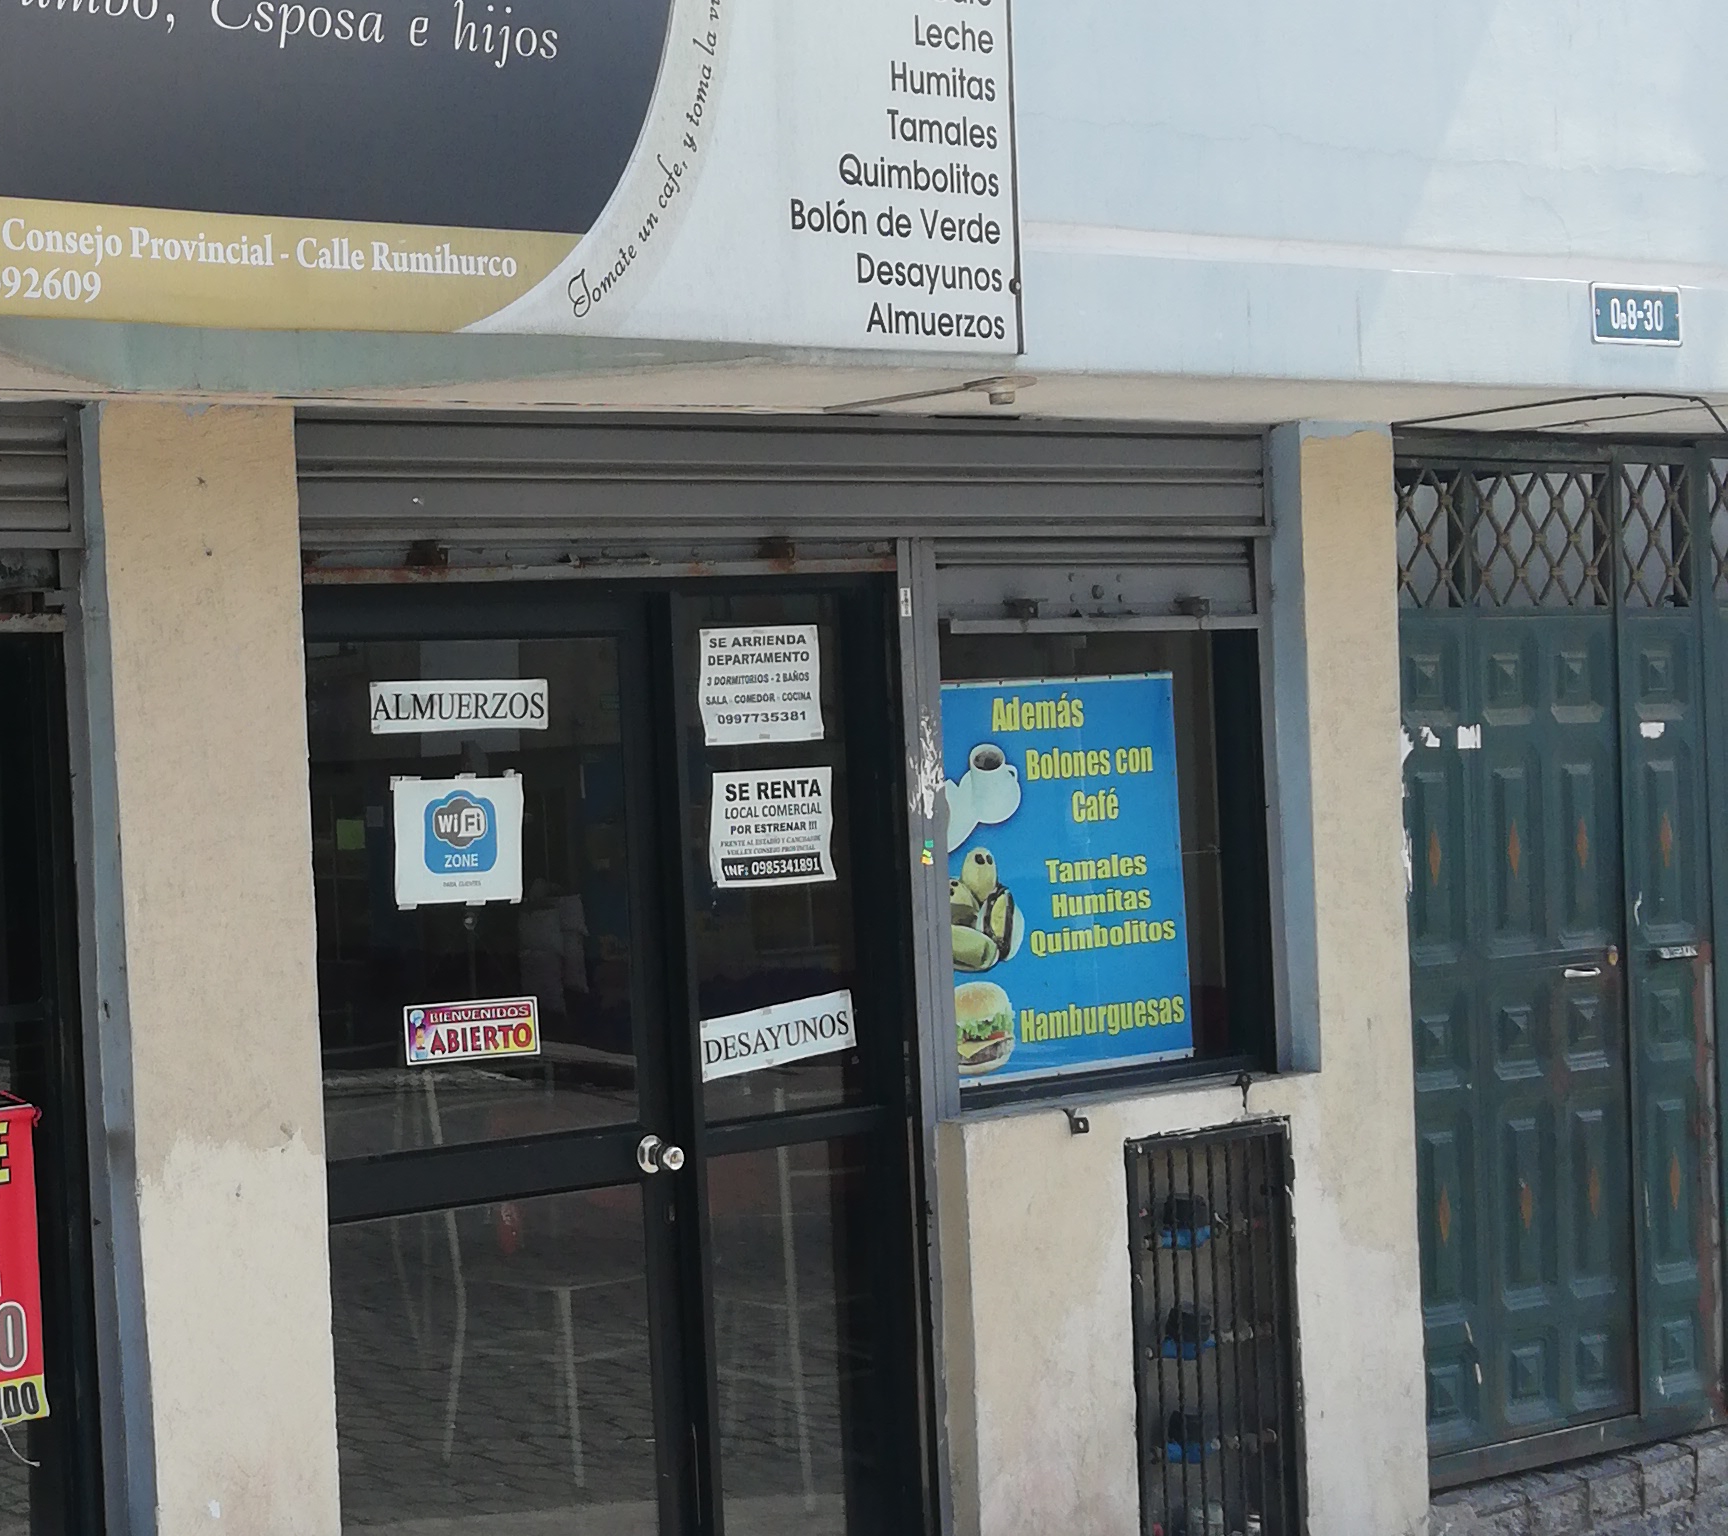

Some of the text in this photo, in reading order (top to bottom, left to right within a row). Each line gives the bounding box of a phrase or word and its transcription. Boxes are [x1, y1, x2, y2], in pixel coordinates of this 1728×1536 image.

[409, 15, 429, 46] e
[454, 0, 559, 69] hijos
[693, 31, 717, 56] la
[915, 15, 993, 54] Leche
[686, 64, 712, 126] toma
[891, 60, 995, 102] Humitas
[683, 132, 697, 152] y
[887, 109, 997, 150] Tamales
[839, 153, 999, 197] Quimbolitos
[638, 213, 658, 243] un
[790, 198, 1000, 244] Bolón de Verde
[2, 218, 122, 266] Consejo
[129, 226, 273, 266] Provincial
[296, 237, 364, 271] Calle
[371, 242, 517, 278] Rumihurco
[568, 244, 637, 317] Tomate
[857, 252, 1002, 295] Desayunos
[866, 302, 1005, 339] Almuerzos
[709, 634, 807, 648] SE ARRIENDA
[708, 651, 810, 666] DEPARTAMENTO
[707, 676, 712, 686] 3
[714, 673, 769, 686] DORMITORIOS
[776, 673, 781, 683] 2
[782, 670, 810, 682] BAÑOS
[372, 691, 545, 721] ALMUERZOS
[706, 695, 728, 706] SALA
[734, 693, 775, 705] COMEDOR
[782, 691, 811, 702] COCINA
[991, 692, 1085, 733] Además
[717, 711, 807, 725] 0997735381
[1025, 746, 1154, 781] Bolones con
[725, 779, 822, 802] SE RENTA
[1072, 787, 1119, 823] Café
[725, 802, 822, 820] LOCAL COMERCIAL
[730, 824, 752, 835] POR
[754, 821, 806, 834] ESTRENAR
[444, 853, 478, 868] ZONE
[724, 857, 820, 877] INF: 0985341891
[1045, 853, 1147, 884] Tamales
[1052, 888, 1151, 918] Humitas
[1030, 920, 1176, 957] Quimbolitos
[430, 1006, 529, 1024] BIENVENIDOS
[1020, 995, 1185, 1043] Hamburguesas
[430, 1023, 532, 1055] ABIERTO
[703, 1010, 849, 1065] DESAYUNOS
